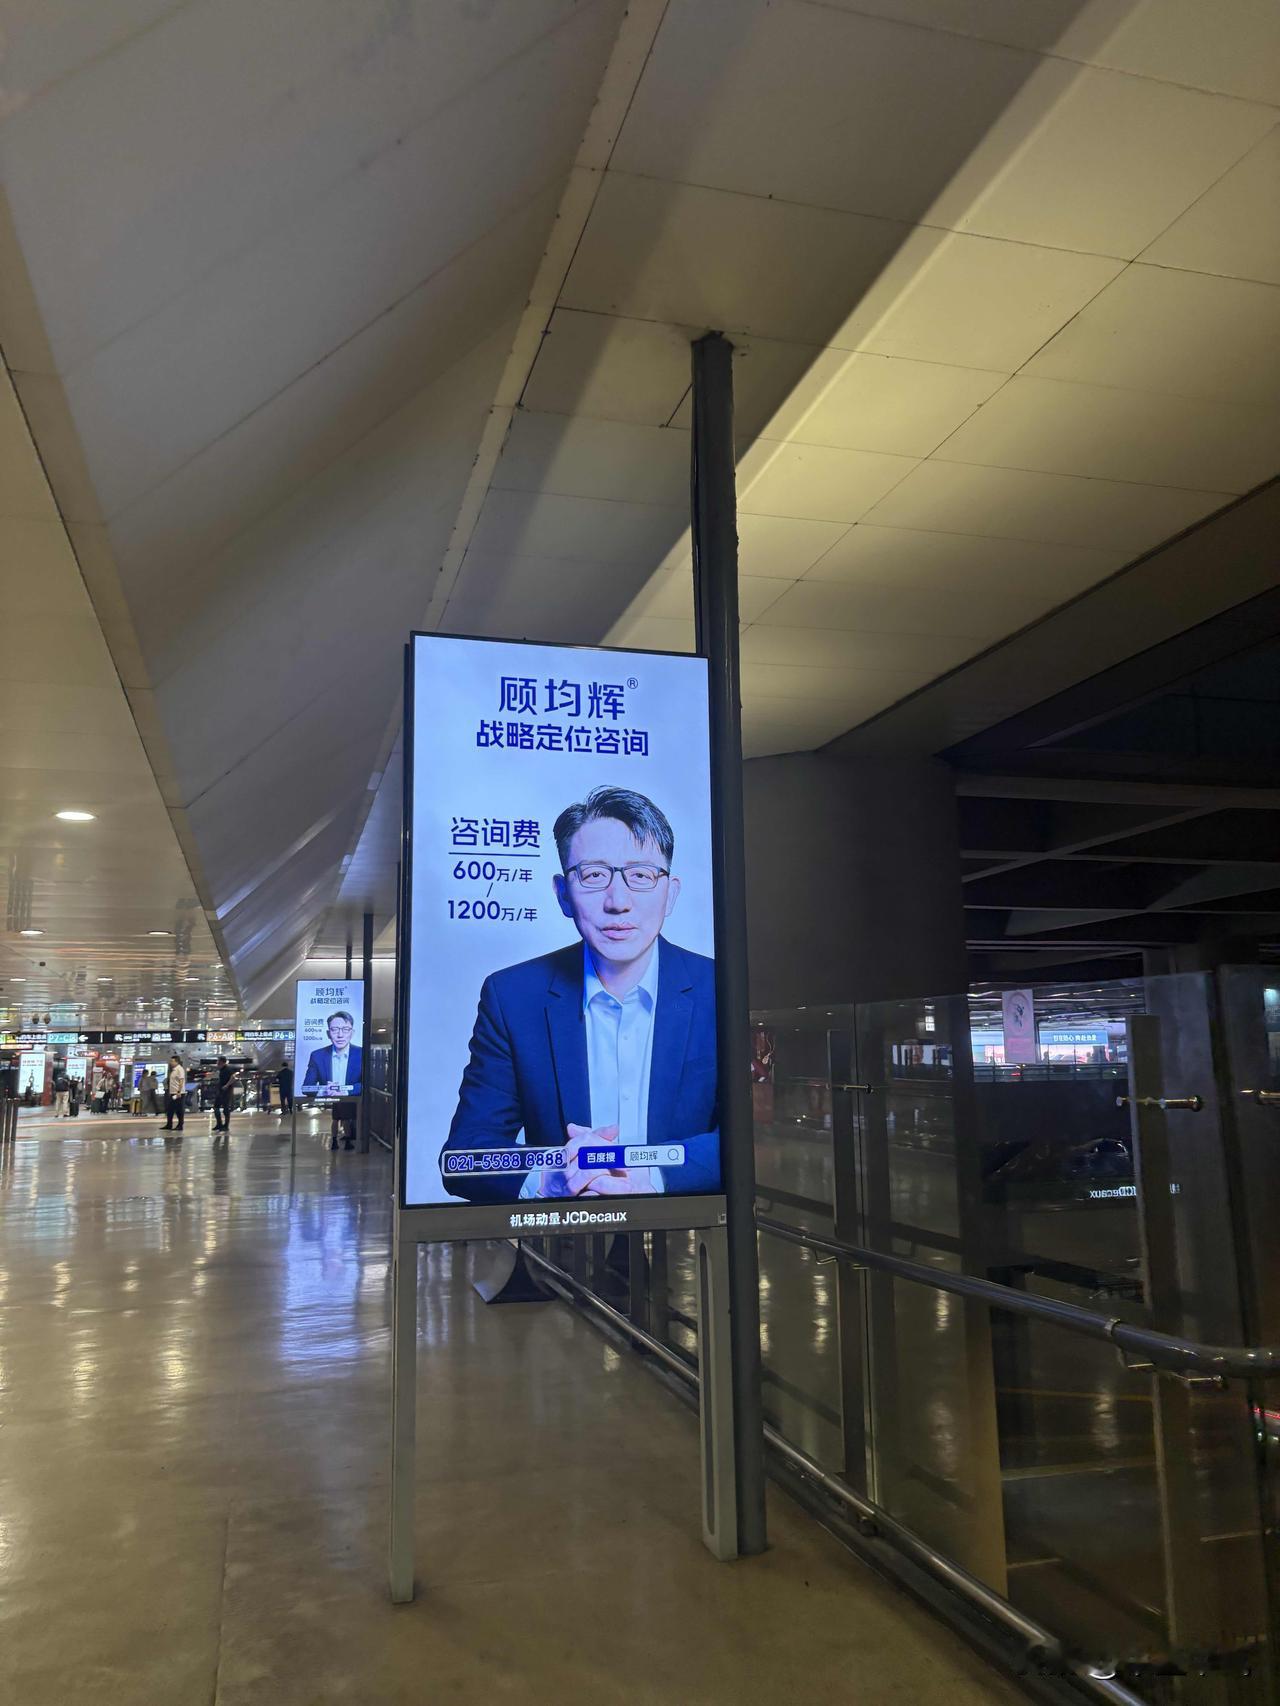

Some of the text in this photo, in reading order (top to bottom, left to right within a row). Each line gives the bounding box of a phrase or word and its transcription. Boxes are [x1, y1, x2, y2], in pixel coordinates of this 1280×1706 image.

[476, 719, 649, 756] 战略定位咨询
[451, 817, 540, 848] 咨询费
[453, 861, 533, 882] 600万/年
[448, 900, 538, 921] 1200万/年
[447, 1151, 564, 1171] 021-5588 8888
[586, 1151, 616, 1163] 百度搜
[629, 1150, 659, 1162] 顾均辉
[510, 1211, 627, 1227] 机场动量 JCDecaux
